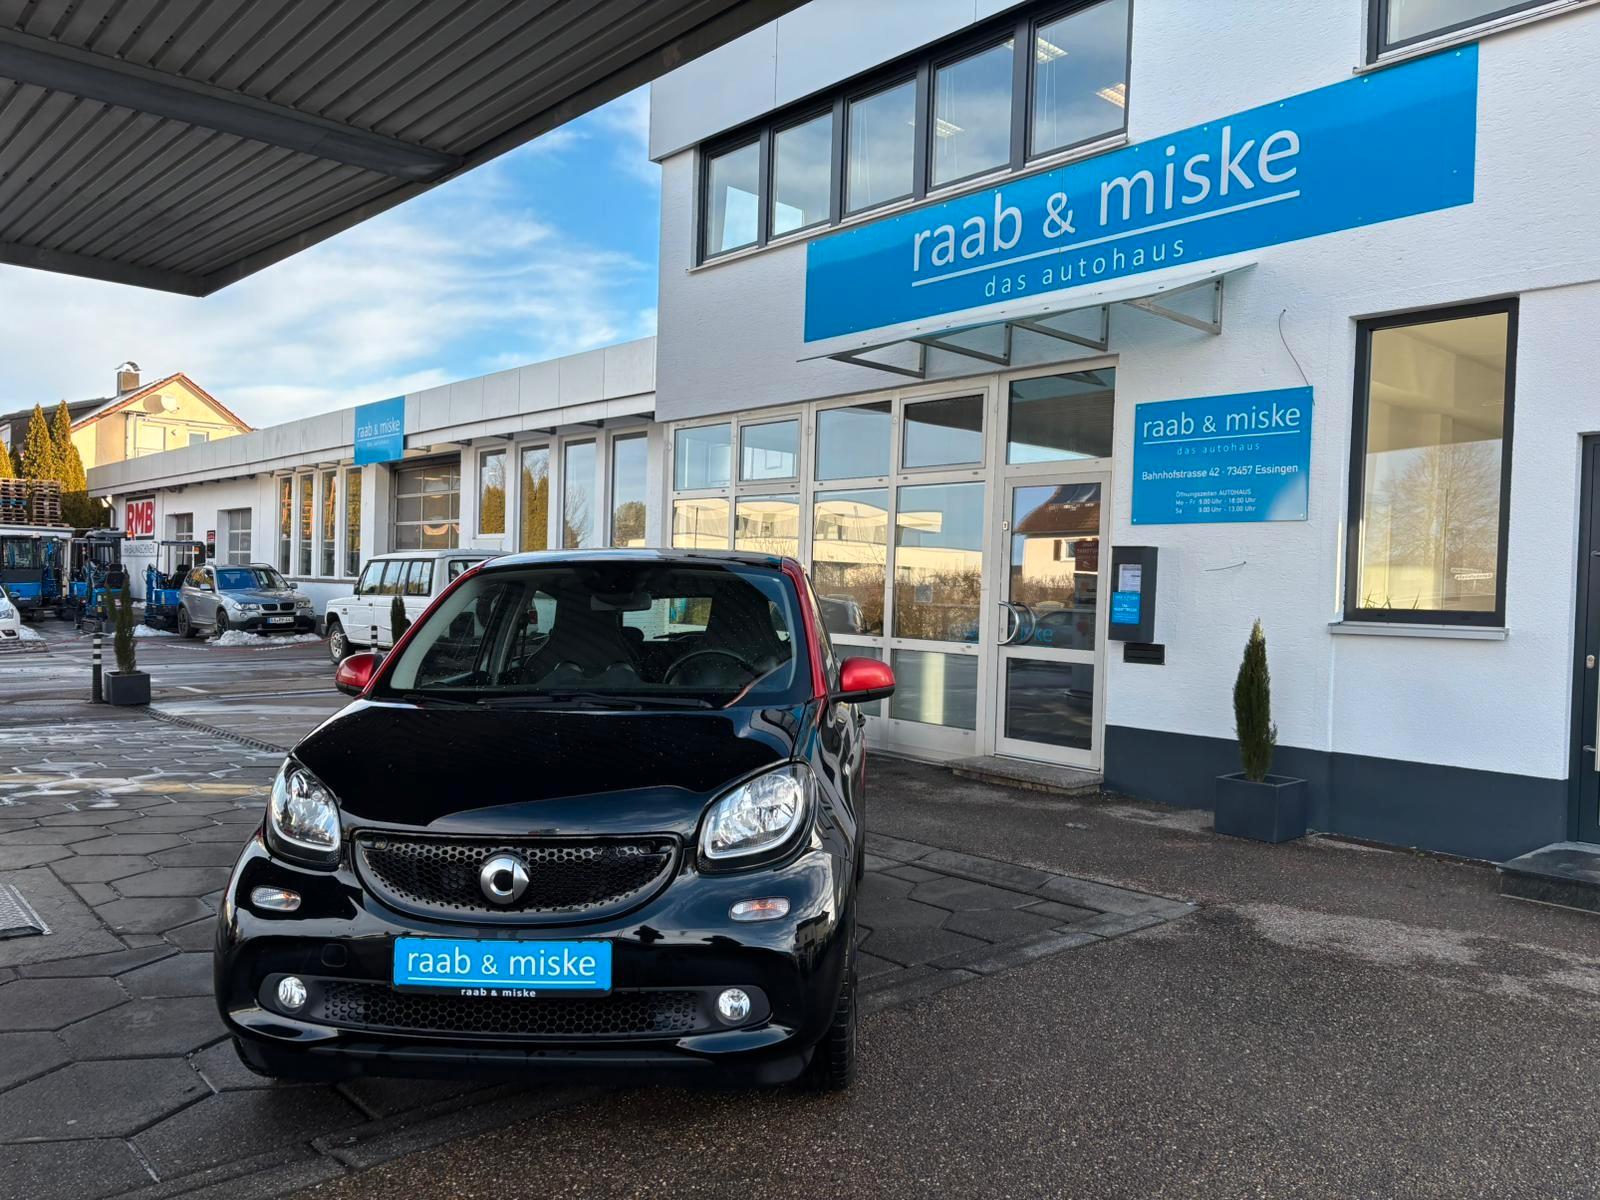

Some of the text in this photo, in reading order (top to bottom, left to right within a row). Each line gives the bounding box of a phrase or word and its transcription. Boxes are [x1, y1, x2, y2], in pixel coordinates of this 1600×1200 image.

[913, 125, 1300, 272] raab & miske
[985, 240, 1184, 297] das autohaus
[357, 421, 373, 439] raab
[380, 416, 401, 433] miske
[1143, 402, 1300, 438] raab & miske
[1177, 442, 1260, 455] das autohaus
[1142, 470, 1207, 481] Bahnhofstrasse
[1208, 467, 1220, 477] 42
[1227, 465, 1252, 475] 73457
[1255, 463, 1299, 476] Essingen
[1218, 488, 1252, 496] AUTOHAUS
[127, 501, 154, 537] RMB
[407, 946, 596, 977] raab & miske
[460, 988, 487, 996] raab
[502, 989, 537, 998] miske
